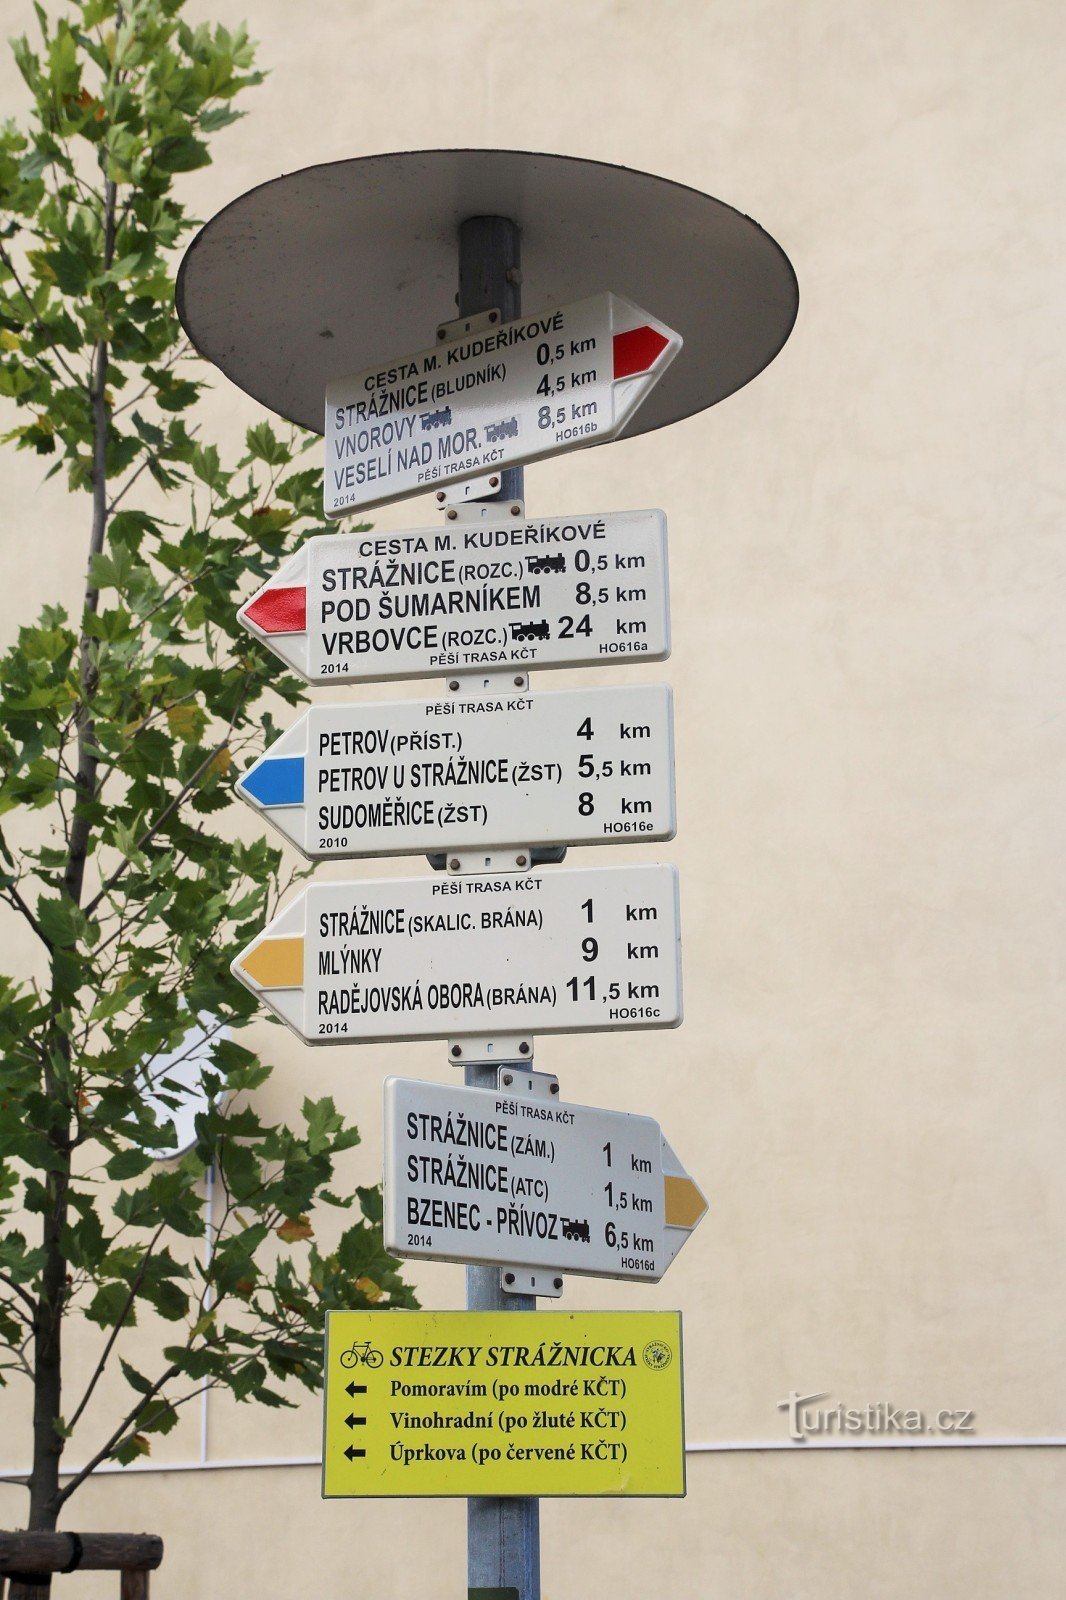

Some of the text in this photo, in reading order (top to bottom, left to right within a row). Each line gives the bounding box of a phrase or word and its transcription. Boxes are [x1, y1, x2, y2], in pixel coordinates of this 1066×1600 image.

[364, 311, 564, 391] CESTA M. KUDEŘÍKOVÉ
[537, 338, 596, 366] 0,5 km
[536, 370, 596, 396] 4,5 km
[335, 381, 428, 430] STRÁŽNICE
[538, 402, 597, 429] 8,5 km
[335, 414, 416, 459] VNOROVY
[556, 422, 599, 442] HO616b
[334, 428, 481, 490] VESELÍ NAD MOR.
[418, 448, 504, 483] PĚŠÍ TRASA KČT
[334, 493, 355, 507] 2014
[359, 520, 605, 557] CESTA M. KUDEŘÍKOVÉ
[575, 549, 645, 574] 0,5 km
[322, 560, 455, 592] STRÁŽNICE
[322, 584, 540, 623] POD ŠUMARNÍKEM
[576, 582, 646, 607] 8,5 km
[558, 614, 646, 639] 24 km
[322, 625, 438, 655] VRBOVCE
[600, 641, 647, 653] HO616a
[321, 663, 349, 674] 2014
[430, 647, 537, 665] PĚŠÍ TRASA KČT
[426, 698, 533, 715] PĚŠÍ TRASA KČT
[577, 717, 650, 740] 4 km
[394, 765, 404, 788] U
[411, 756, 508, 787] STRÁŽNICE
[578, 754, 651, 780] 5,5 km
[319, 798, 434, 830] SUDOMĚŘICE
[578, 792, 651, 816] 8 km
[604, 821, 653, 833] HO616e
[319, 837, 347, 848] 2010
[433, 877, 542, 895] PĚŠÍ TRASA KČT
[320, 906, 404, 937] STRÁŽNICE
[481, 907, 542, 930] BRÁNA)
[581, 899, 657, 923] 1 km
[319, 944, 382, 975] MLÝNKY
[582, 937, 658, 962] 9 km
[319, 979, 423, 1015] RADĚJOVSKÁ
[428, 983, 484, 1009] OBORA
[566, 977, 659, 1003] 11,5 km
[610, 1007, 660, 1019] HO616c
[319, 1023, 348, 1034] 2014
[496, 1100, 575, 1124] PĚŠÍ TRASA KČT
[407, 1112, 507, 1151] STRÁŽNICE
[603, 1142, 651, 1173] 1 km
[407, 1154, 508, 1193] STRÁŽNICE
[605, 1183, 652, 1212] 1,5 km
[408, 1197, 480, 1231] BZENEC
[497, 1202, 558, 1240] PŘÍVOZ
[408, 1234, 432, 1247] 2014
[605, 1222, 653, 1252] 6,5 km
[621, 1257, 654, 1271] HO616d
[390, 1347, 482, 1367] STEZKY
[486, 1342, 637, 1366] STRÁŽNICKA
[391, 1376, 626, 1401] Pomoravím (po modré KČT)
[390, 1408, 626, 1433] Vinohradní (po žluté KČT)
[390, 1439, 627, 1465] Úprkova (po červené KČT)
